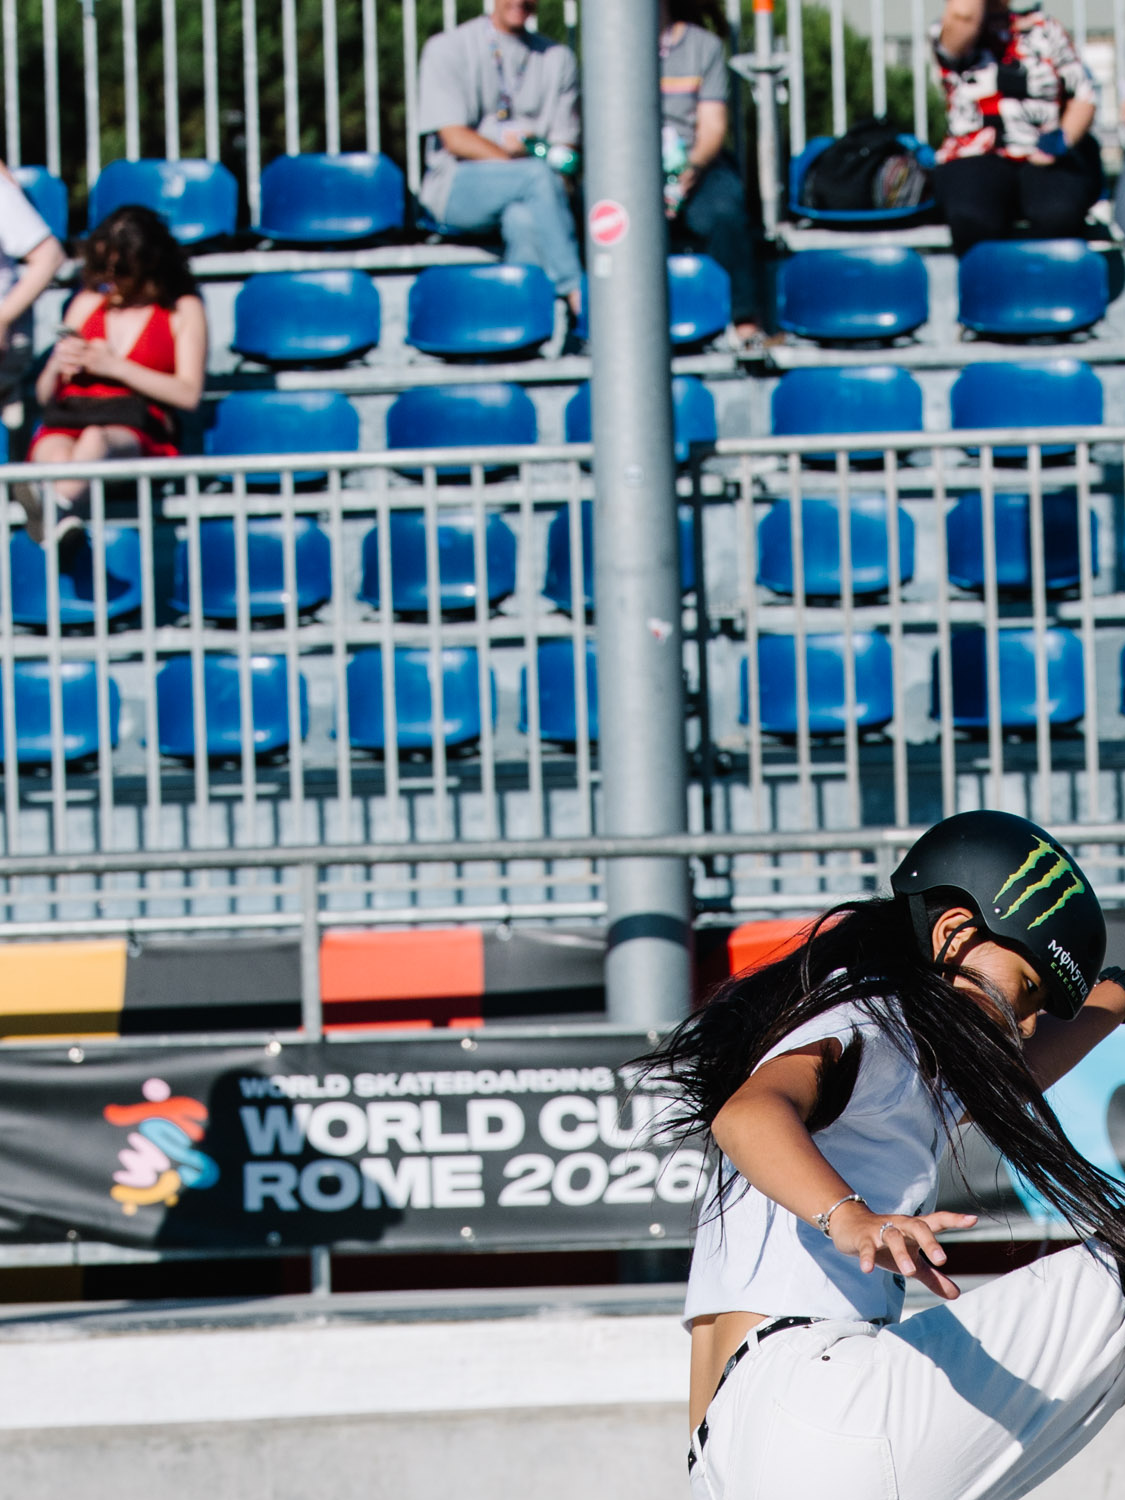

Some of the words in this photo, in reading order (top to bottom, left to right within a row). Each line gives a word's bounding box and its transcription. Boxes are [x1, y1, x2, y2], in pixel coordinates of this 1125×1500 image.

[1048, 939, 1088, 1001] MONSTER
[239, 1074, 351, 1098] WORLD
[354, 1067, 615, 1097] SKATEBOARDING
[239, 1098, 525, 1156] WORLD
[242, 1155, 485, 1212] ROME
[498, 1150, 711, 1207] 2026
